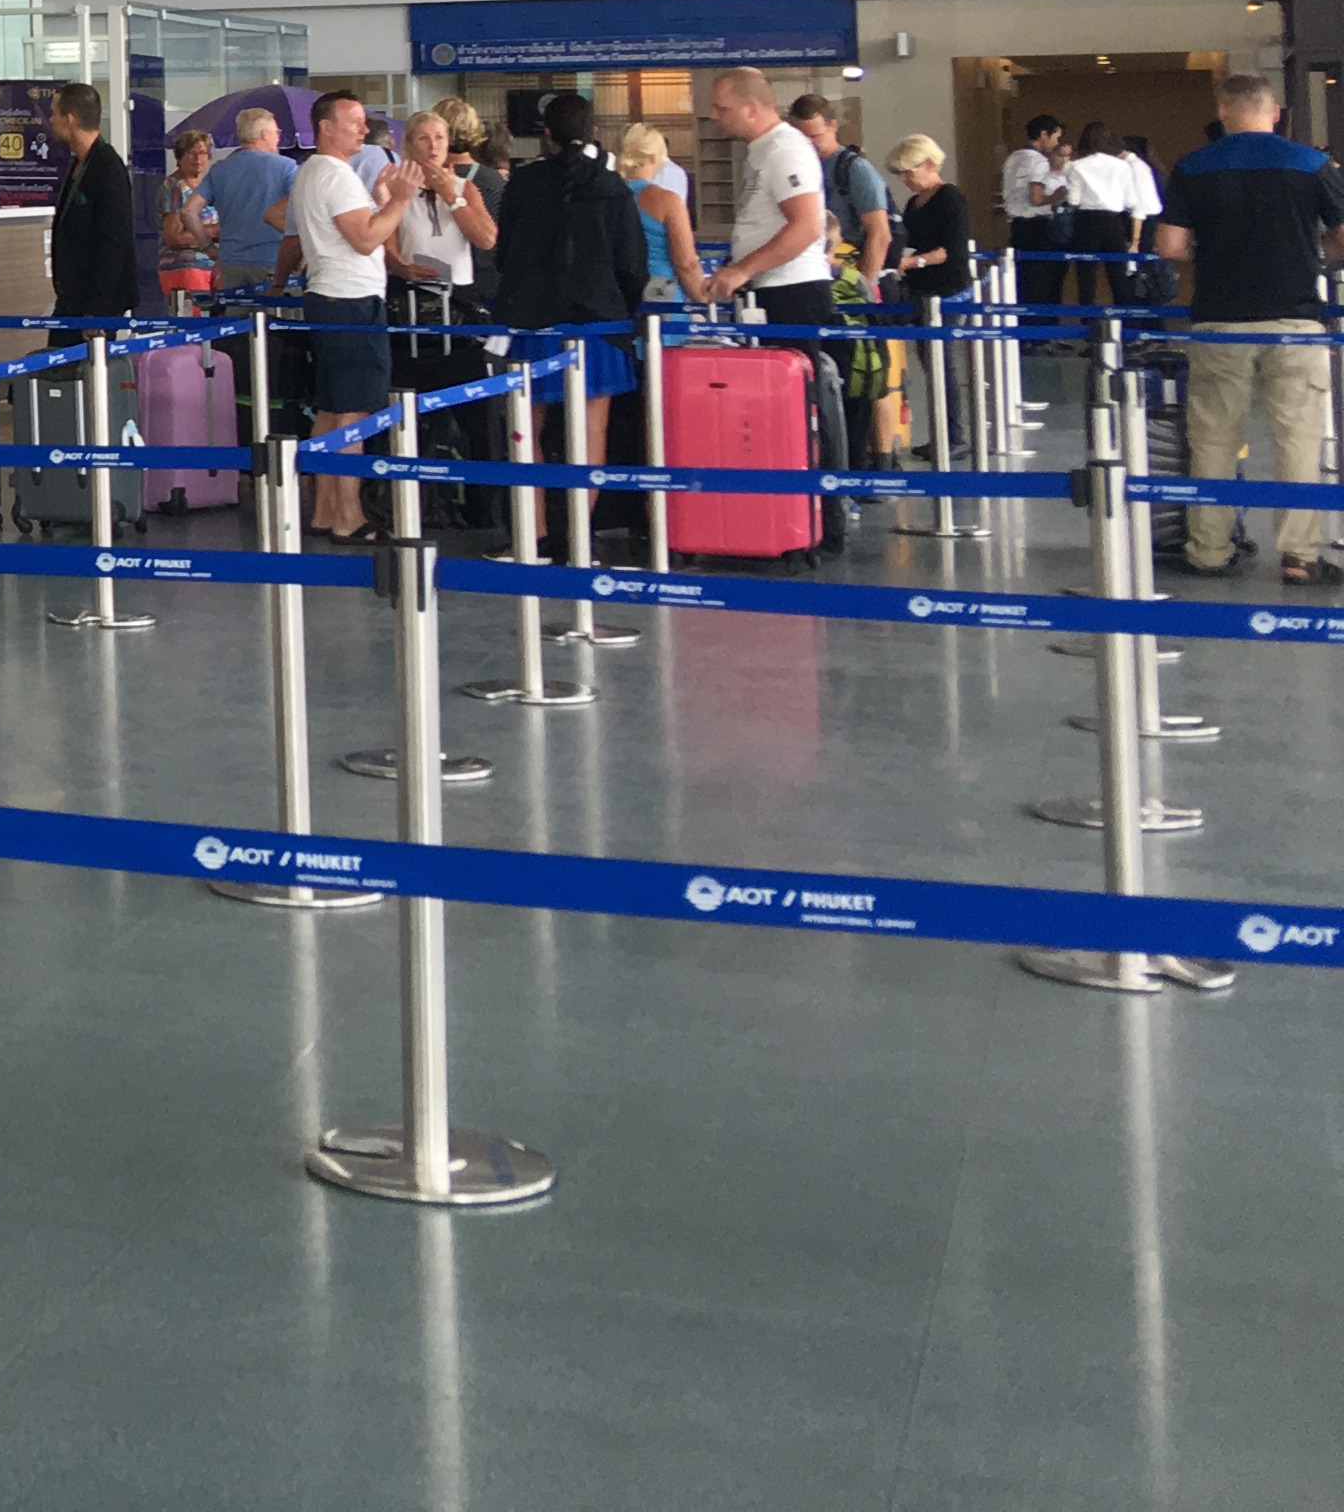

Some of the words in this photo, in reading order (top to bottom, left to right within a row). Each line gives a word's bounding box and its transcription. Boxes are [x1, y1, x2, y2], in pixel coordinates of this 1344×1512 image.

[0, 135, 23, 152] 40
[229, 847, 274, 865] AOT
[296, 852, 362, 871] PHUKET
[726, 887, 777, 905] AOT
[801, 892, 875, 911] PHUKET
[1282, 926, 1339, 946] AOT
